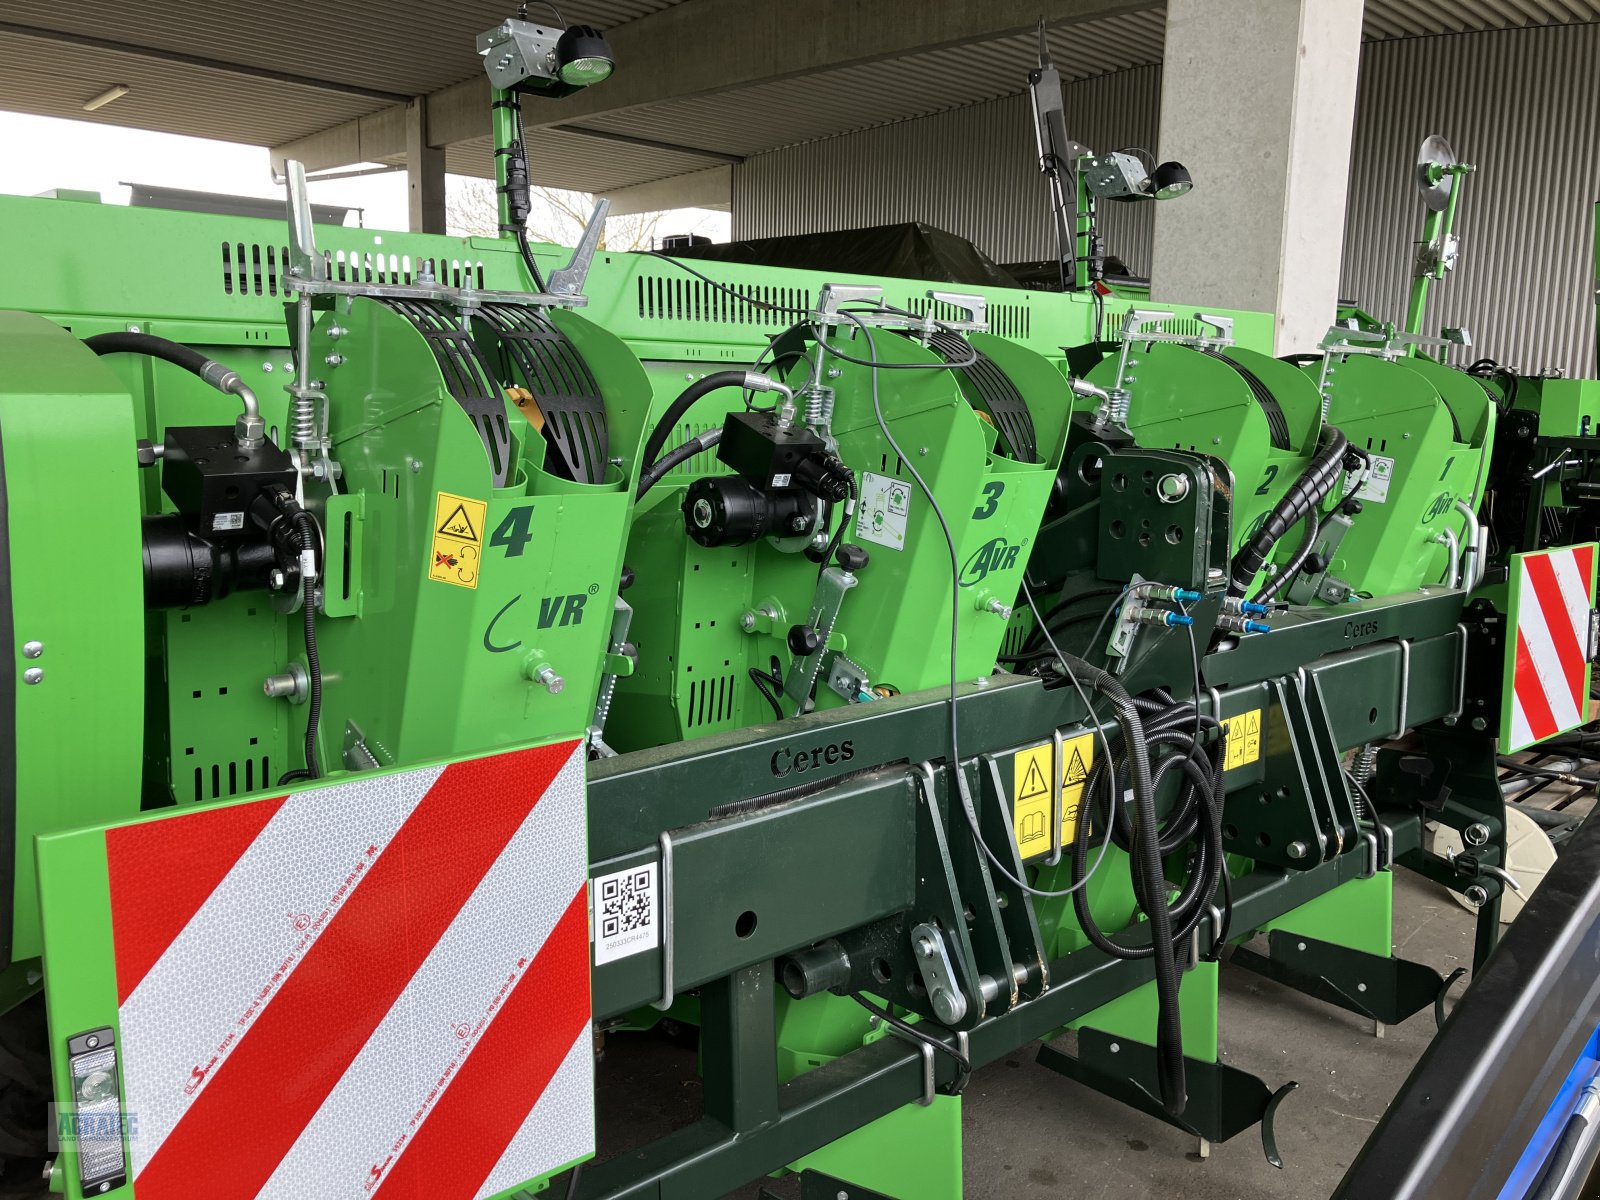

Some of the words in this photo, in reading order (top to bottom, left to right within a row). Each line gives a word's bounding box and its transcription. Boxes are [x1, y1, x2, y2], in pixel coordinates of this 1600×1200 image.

[1254, 464, 1279, 496] 2
[1439, 456, 1455, 481] 1
[972, 481, 1005, 520] 3
[489, 505, 535, 558] 4
[1344, 620, 1378, 639] Ceres
[770, 739, 855, 779] Ceres
